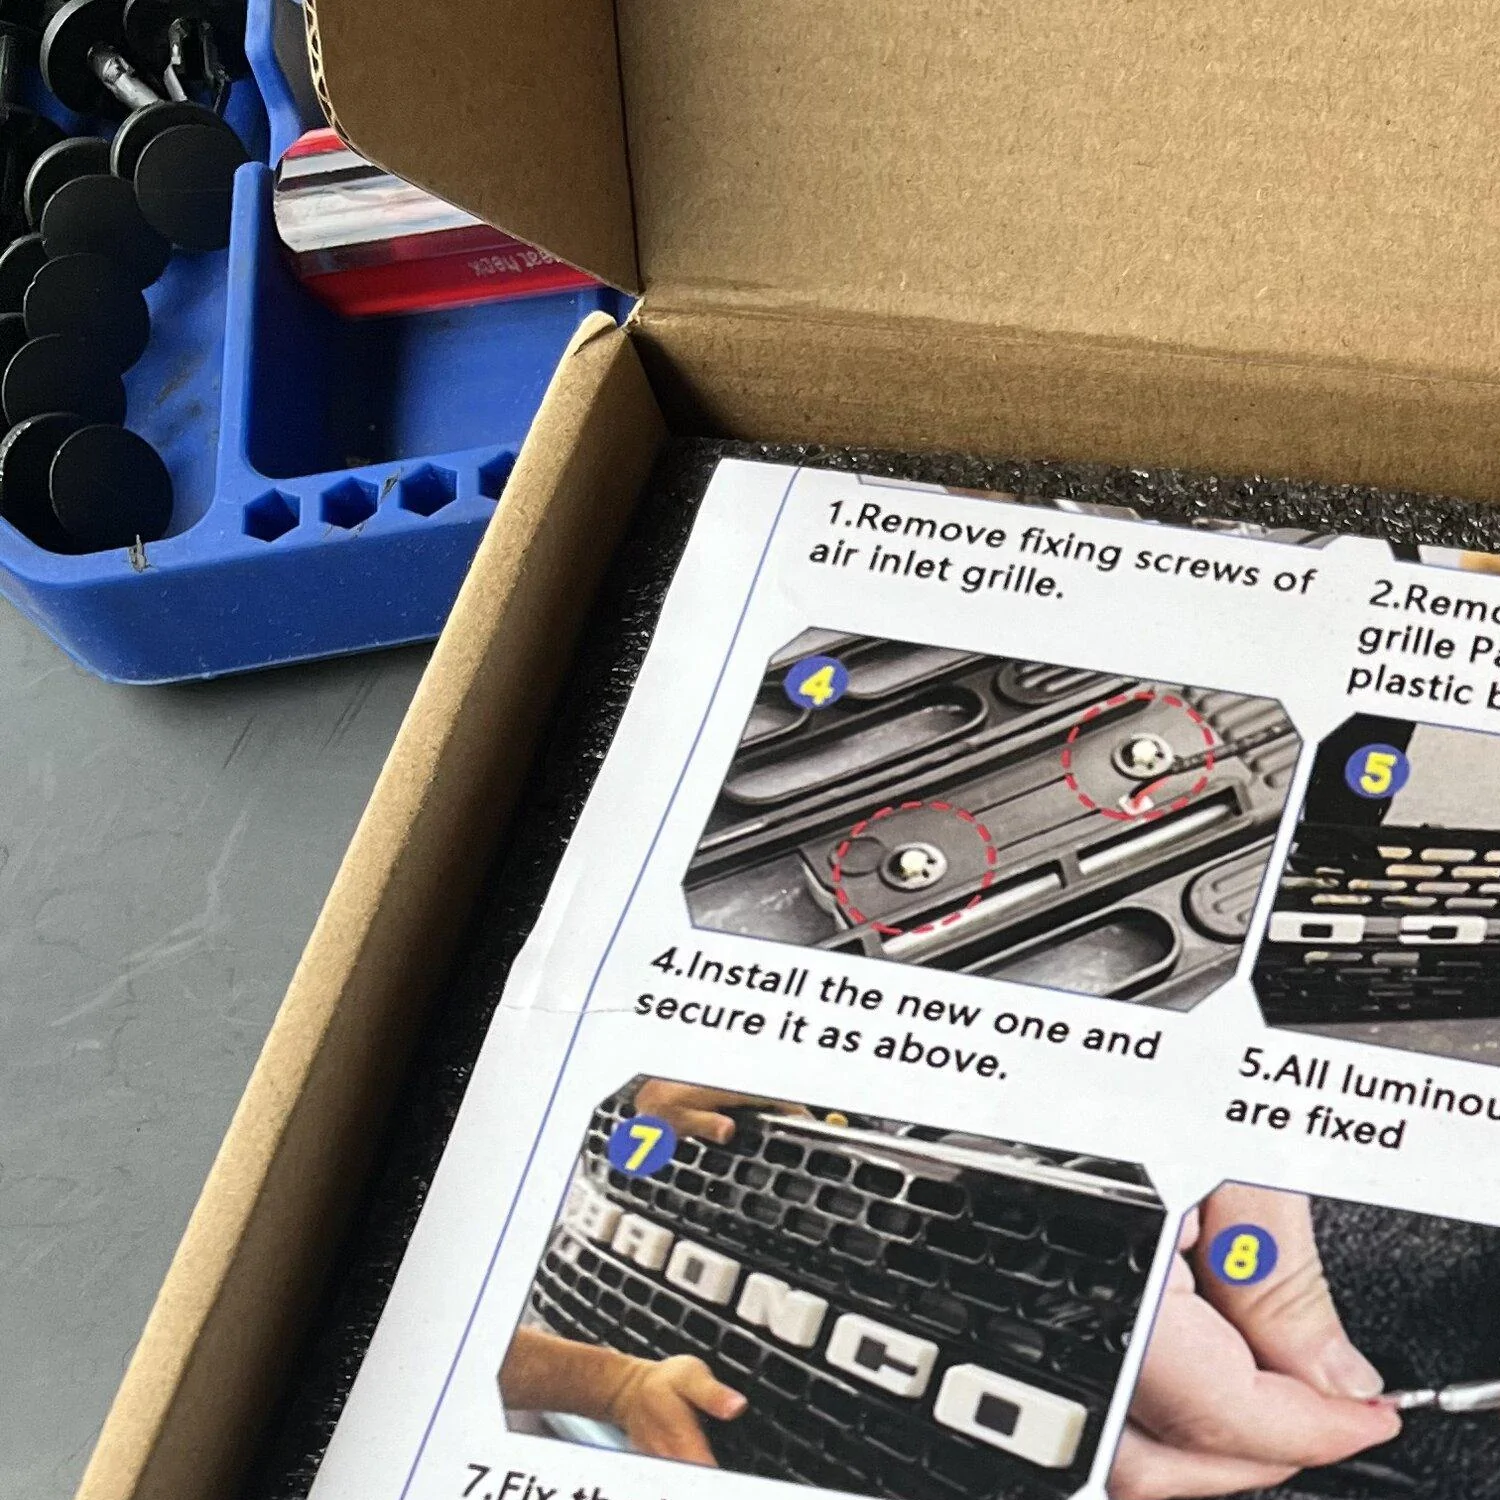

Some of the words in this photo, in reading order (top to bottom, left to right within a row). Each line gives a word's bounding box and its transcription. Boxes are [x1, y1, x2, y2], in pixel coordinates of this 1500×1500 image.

[808, 539, 860, 567] air
[868, 544, 953, 582] inlet
[960, 563, 1064, 600] grille.
[830, 500, 1007, 549] 1.Remove
[1019, 526, 1123, 573] fixing
[1134, 550, 1260, 587] screws
[1272, 568, 1319, 595] of
[1357, 624, 1456, 660] grille
[802, 667, 833, 703] 4
[1346, 663, 1474, 706] plastic
[1362, 753, 1395, 793] 5
[650, 946, 809, 997] 4.Install
[819, 976, 884, 1011] the
[896, 994, 982, 1028] new
[993, 1012, 1070, 1044] one
[1082, 1027, 1163, 1060] and
[634, 993, 766, 1036] secure
[778, 1010, 808, 1044] it
[817, 1026, 862, 1053] as
[873, 1031, 1007, 1080] above.
[1239, 1046, 1330, 1090] 5.All
[1225, 1099, 1291, 1130] are
[1306, 1104, 1407, 1150] fixed
[628, 1126, 660, 1169] 7
[1225, 1235, 1258, 1279] 8
